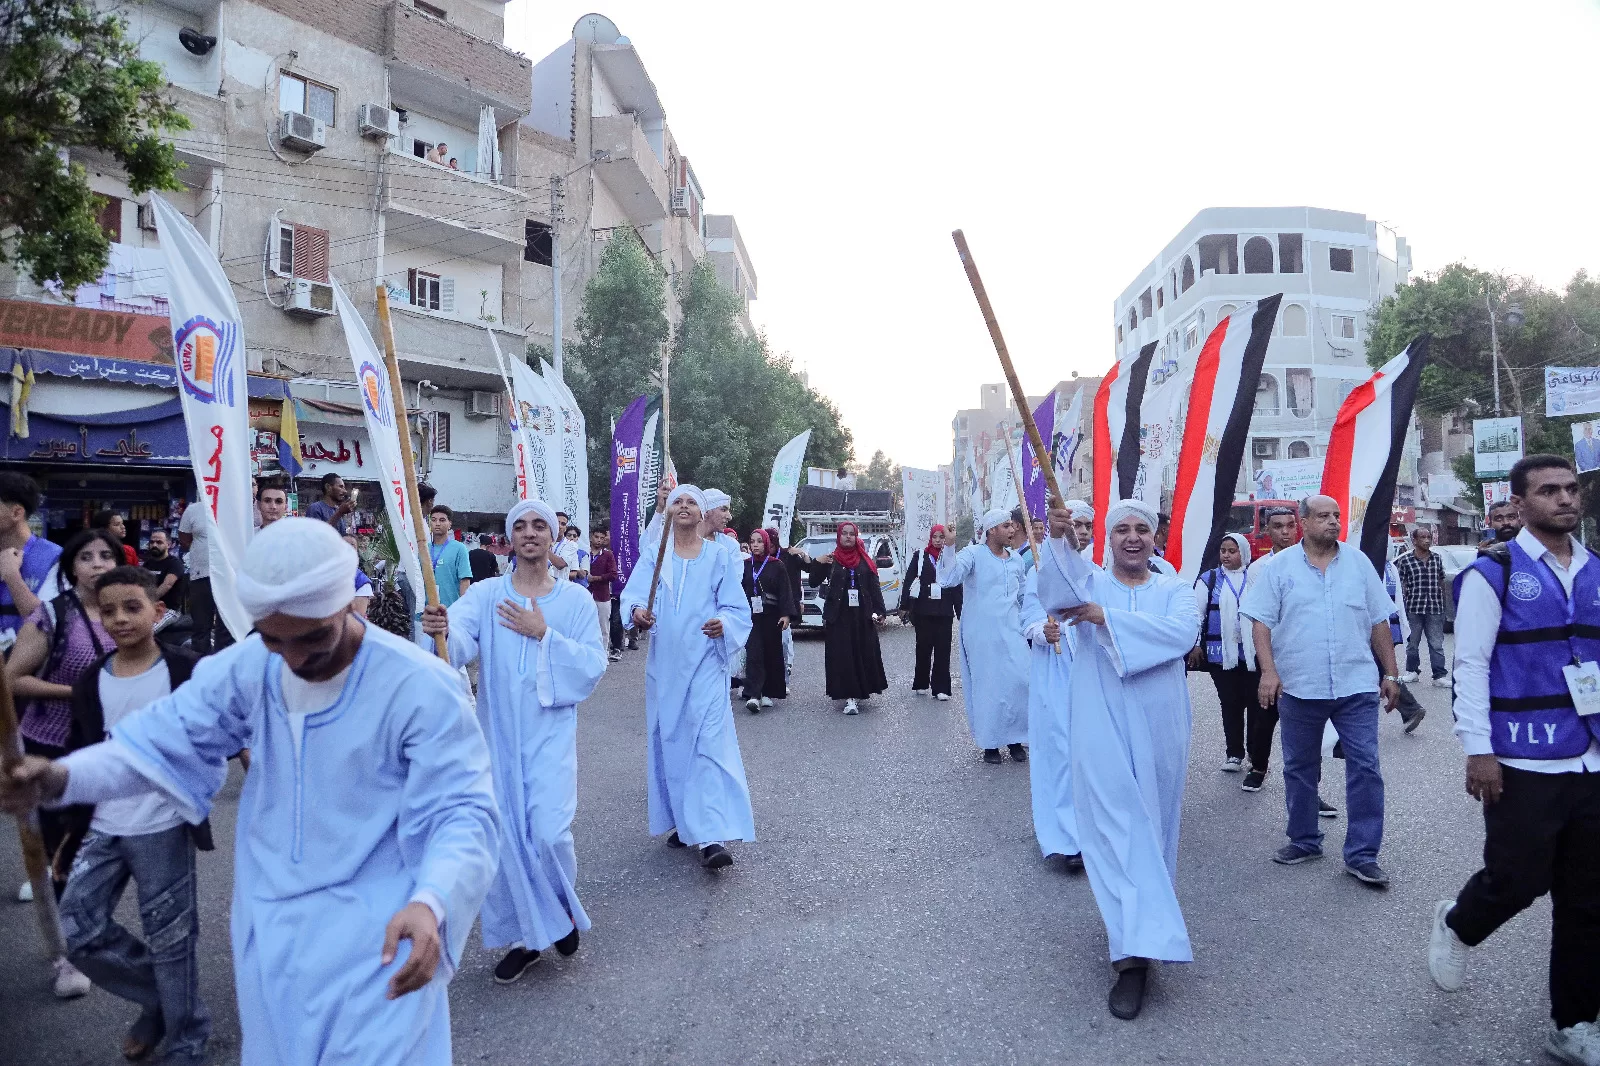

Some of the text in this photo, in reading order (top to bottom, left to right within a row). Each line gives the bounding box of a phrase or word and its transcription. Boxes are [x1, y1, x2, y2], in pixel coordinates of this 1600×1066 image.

[0, 301, 136, 344] EREADY
[135, 369, 177, 385] ركت
[300, 433, 363, 468] المحب
[203, 424, 224, 525] محاف
[517, 443, 527, 500] محاف
[1507, 721, 1557, 744] YLY
